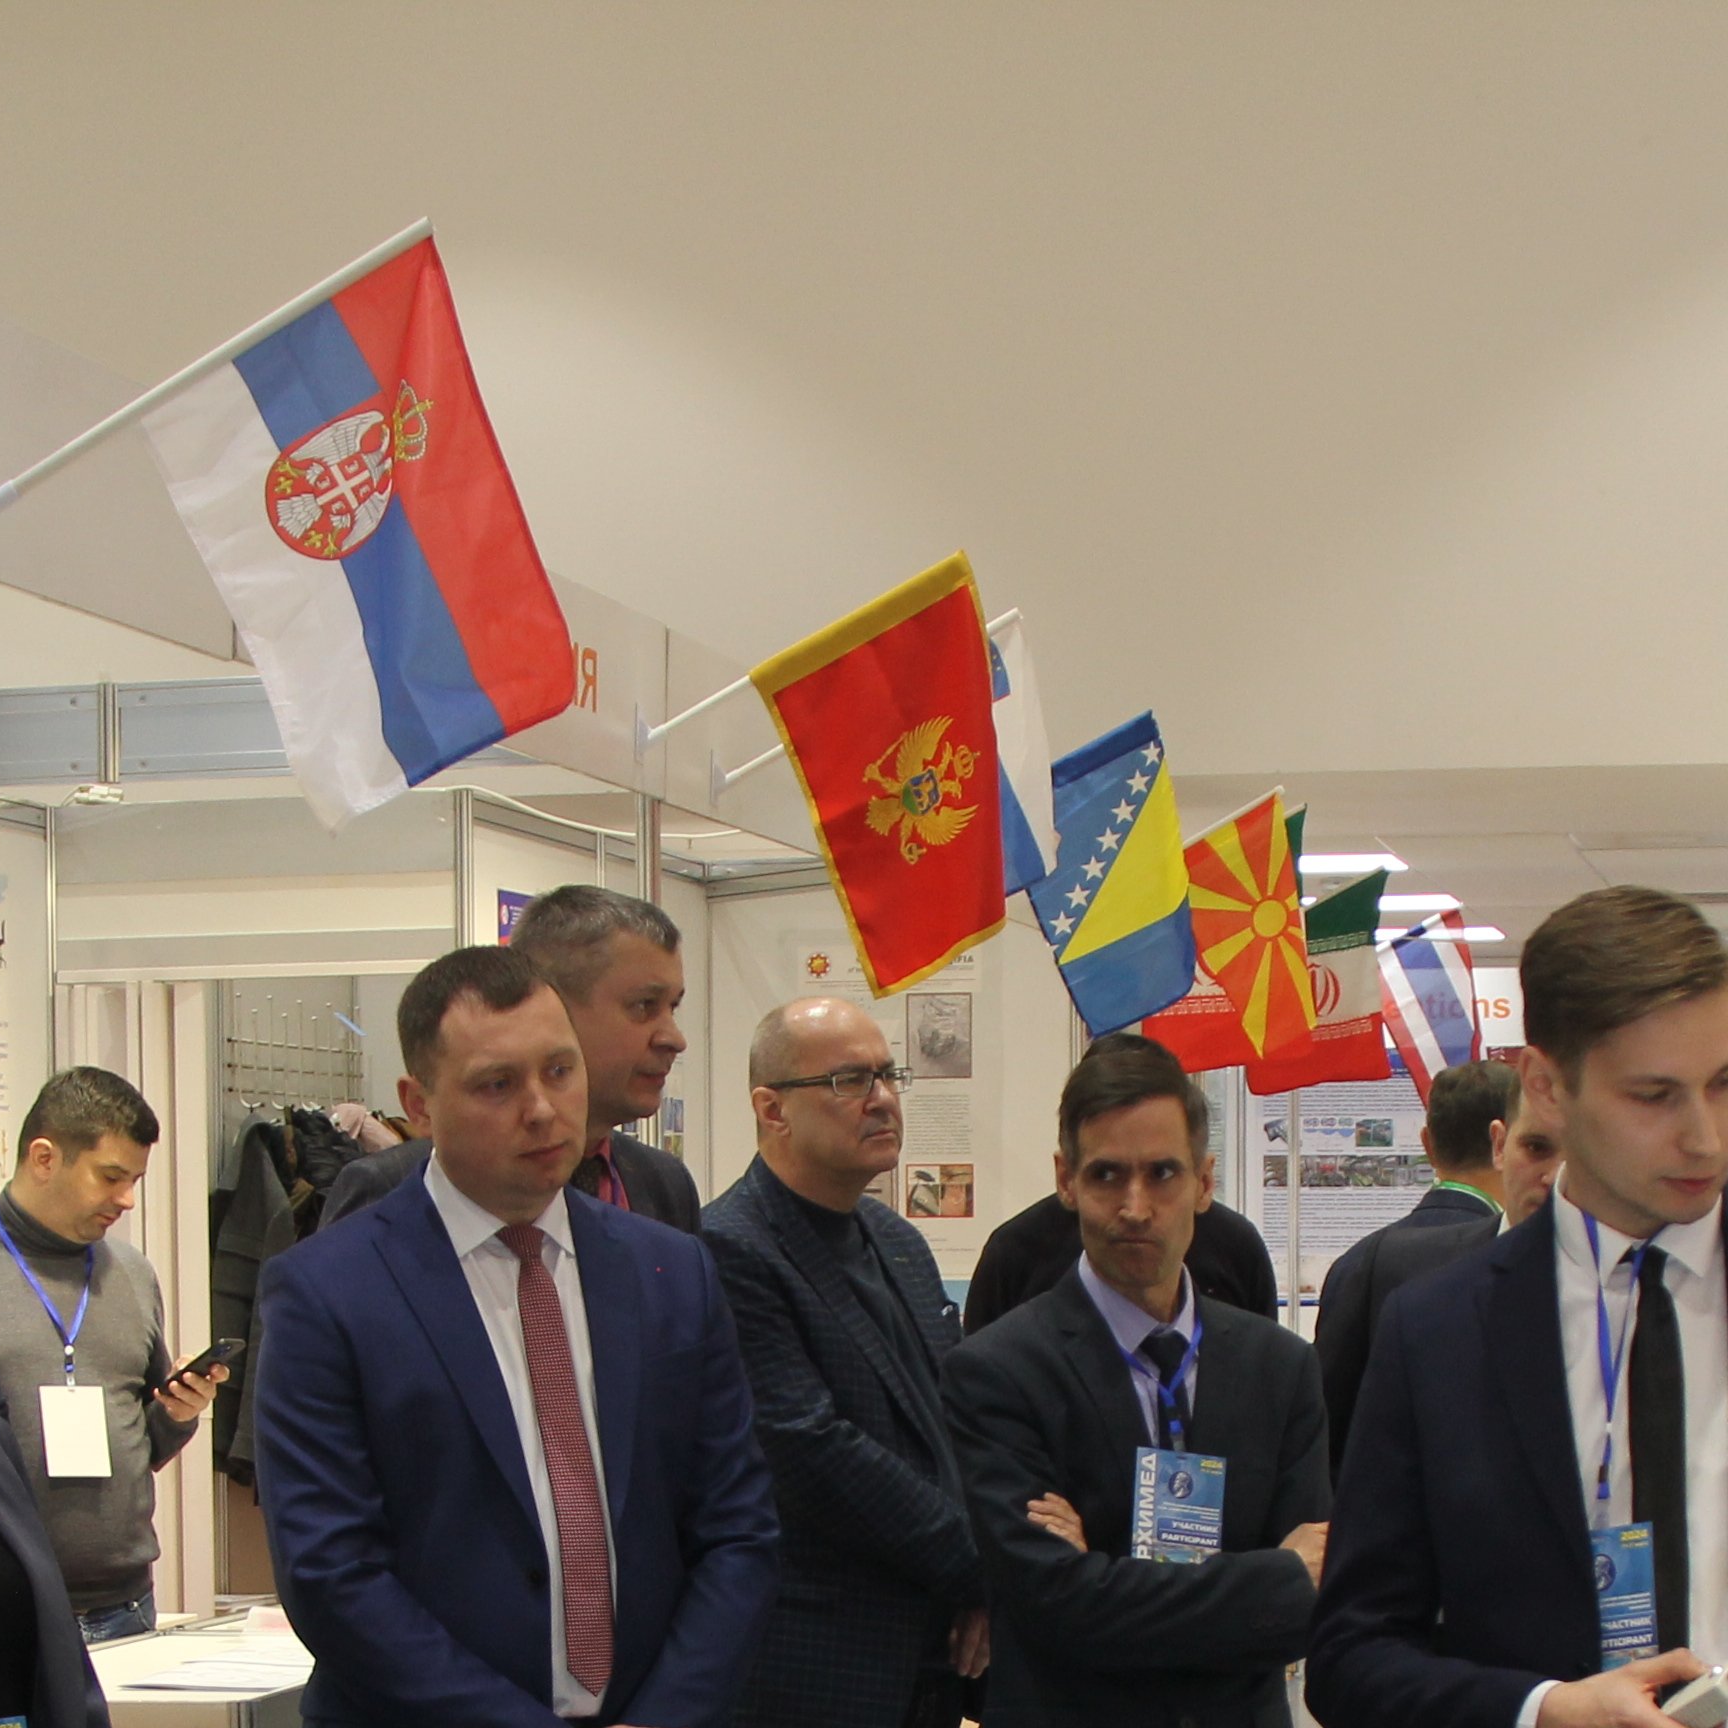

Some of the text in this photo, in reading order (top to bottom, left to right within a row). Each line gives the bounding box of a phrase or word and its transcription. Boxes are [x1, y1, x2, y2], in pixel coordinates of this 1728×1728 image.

[1171, 1520, 1219, 1534] УЧАСТНИК
[1161, 1532, 1218, 1547] PARTICIPANT
[1601, 1616, 1652, 1631] ЧАСТНИК
